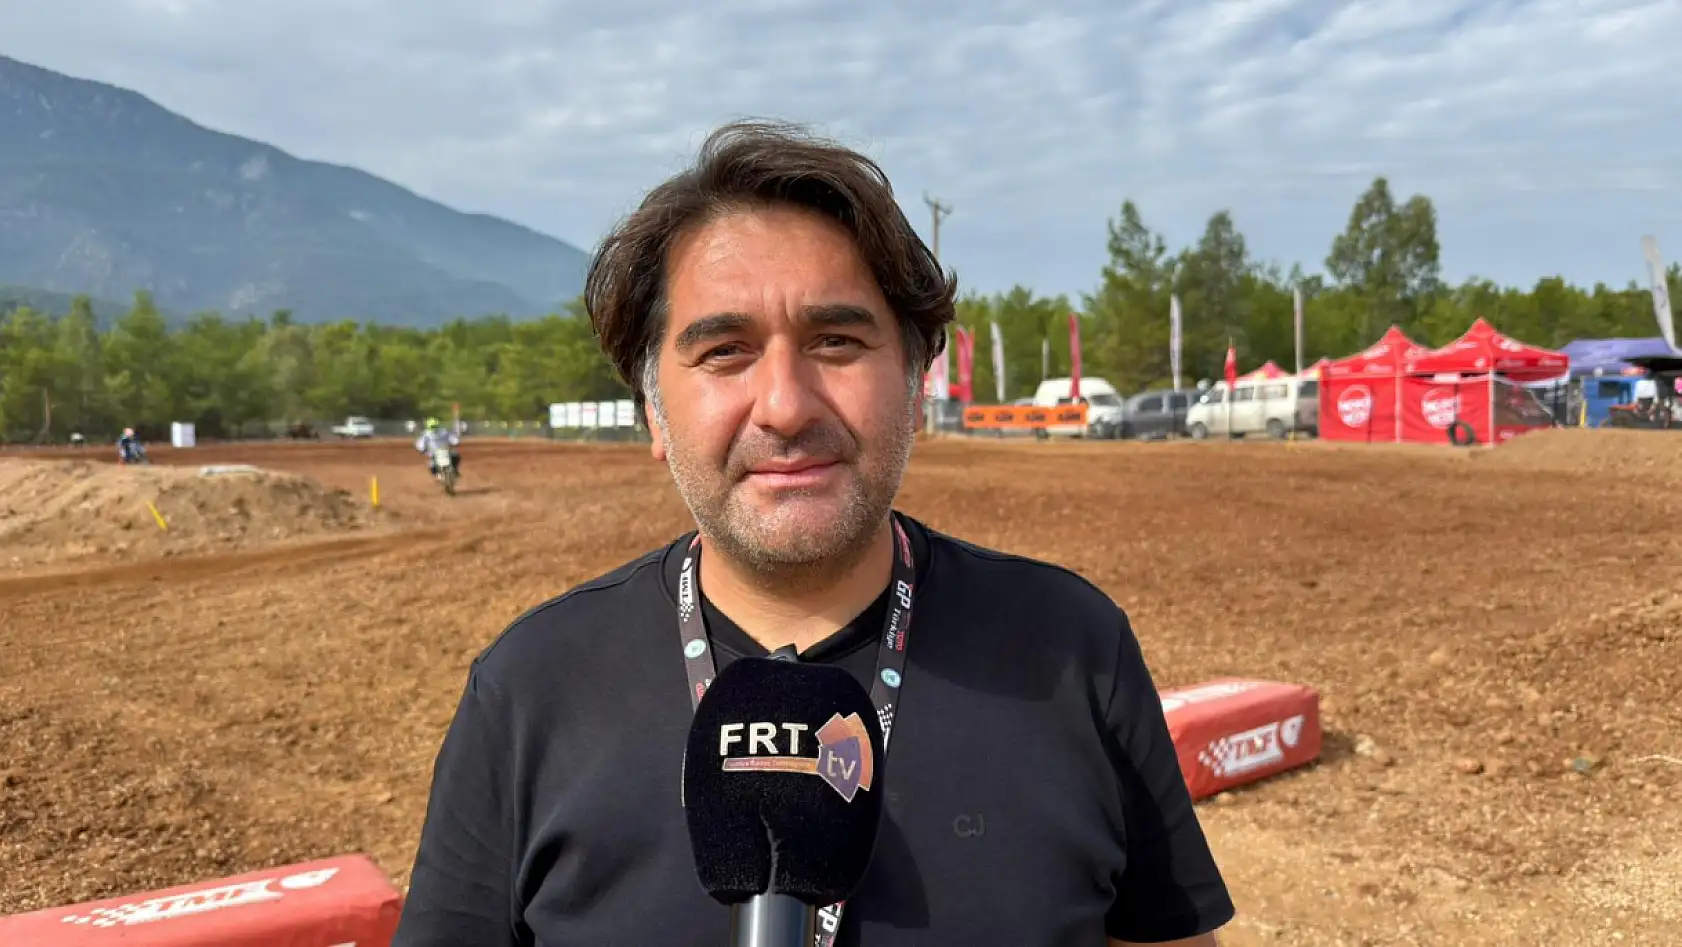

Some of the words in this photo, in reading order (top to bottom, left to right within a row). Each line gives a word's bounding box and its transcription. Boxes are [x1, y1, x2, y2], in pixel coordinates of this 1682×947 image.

[719, 722, 808, 756] FRT
[826, 750, 856, 780] tv
[952, 813, 985, 837] CJ
